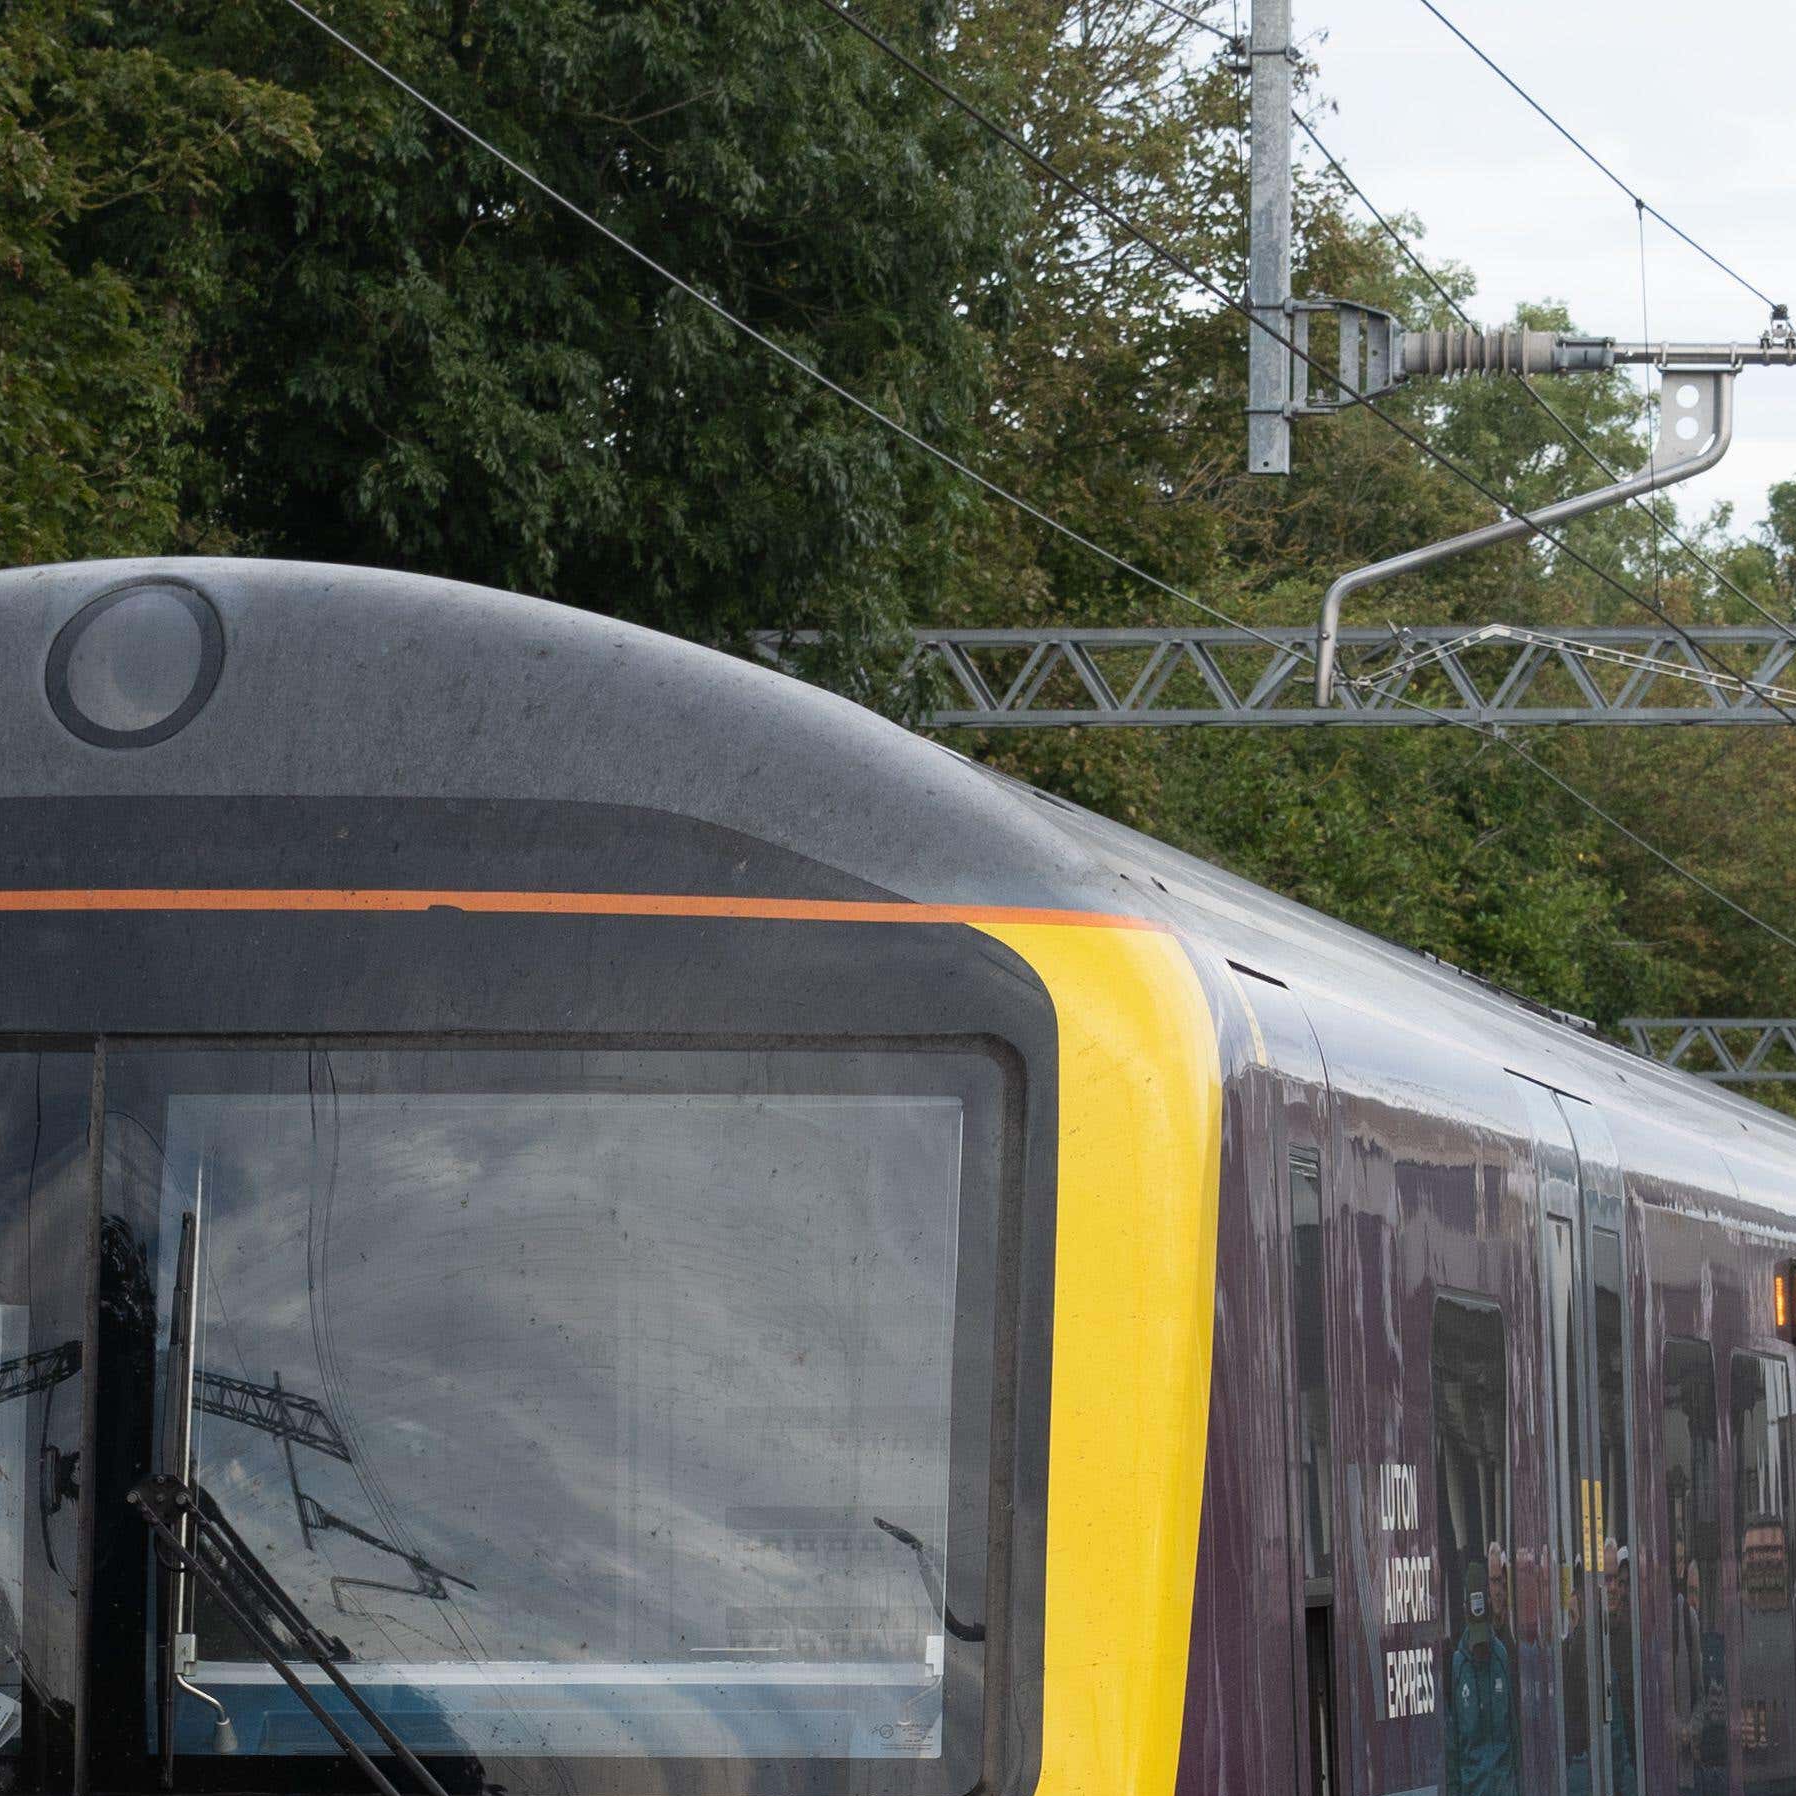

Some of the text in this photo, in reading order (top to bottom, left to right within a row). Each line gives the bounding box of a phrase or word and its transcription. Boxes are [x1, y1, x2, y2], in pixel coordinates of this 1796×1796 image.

[1380, 1463, 1420, 1531] LUTON
[1384, 1555, 1432, 1625] AIRPORT
[1386, 1647, 1436, 1719] EXPRESS
